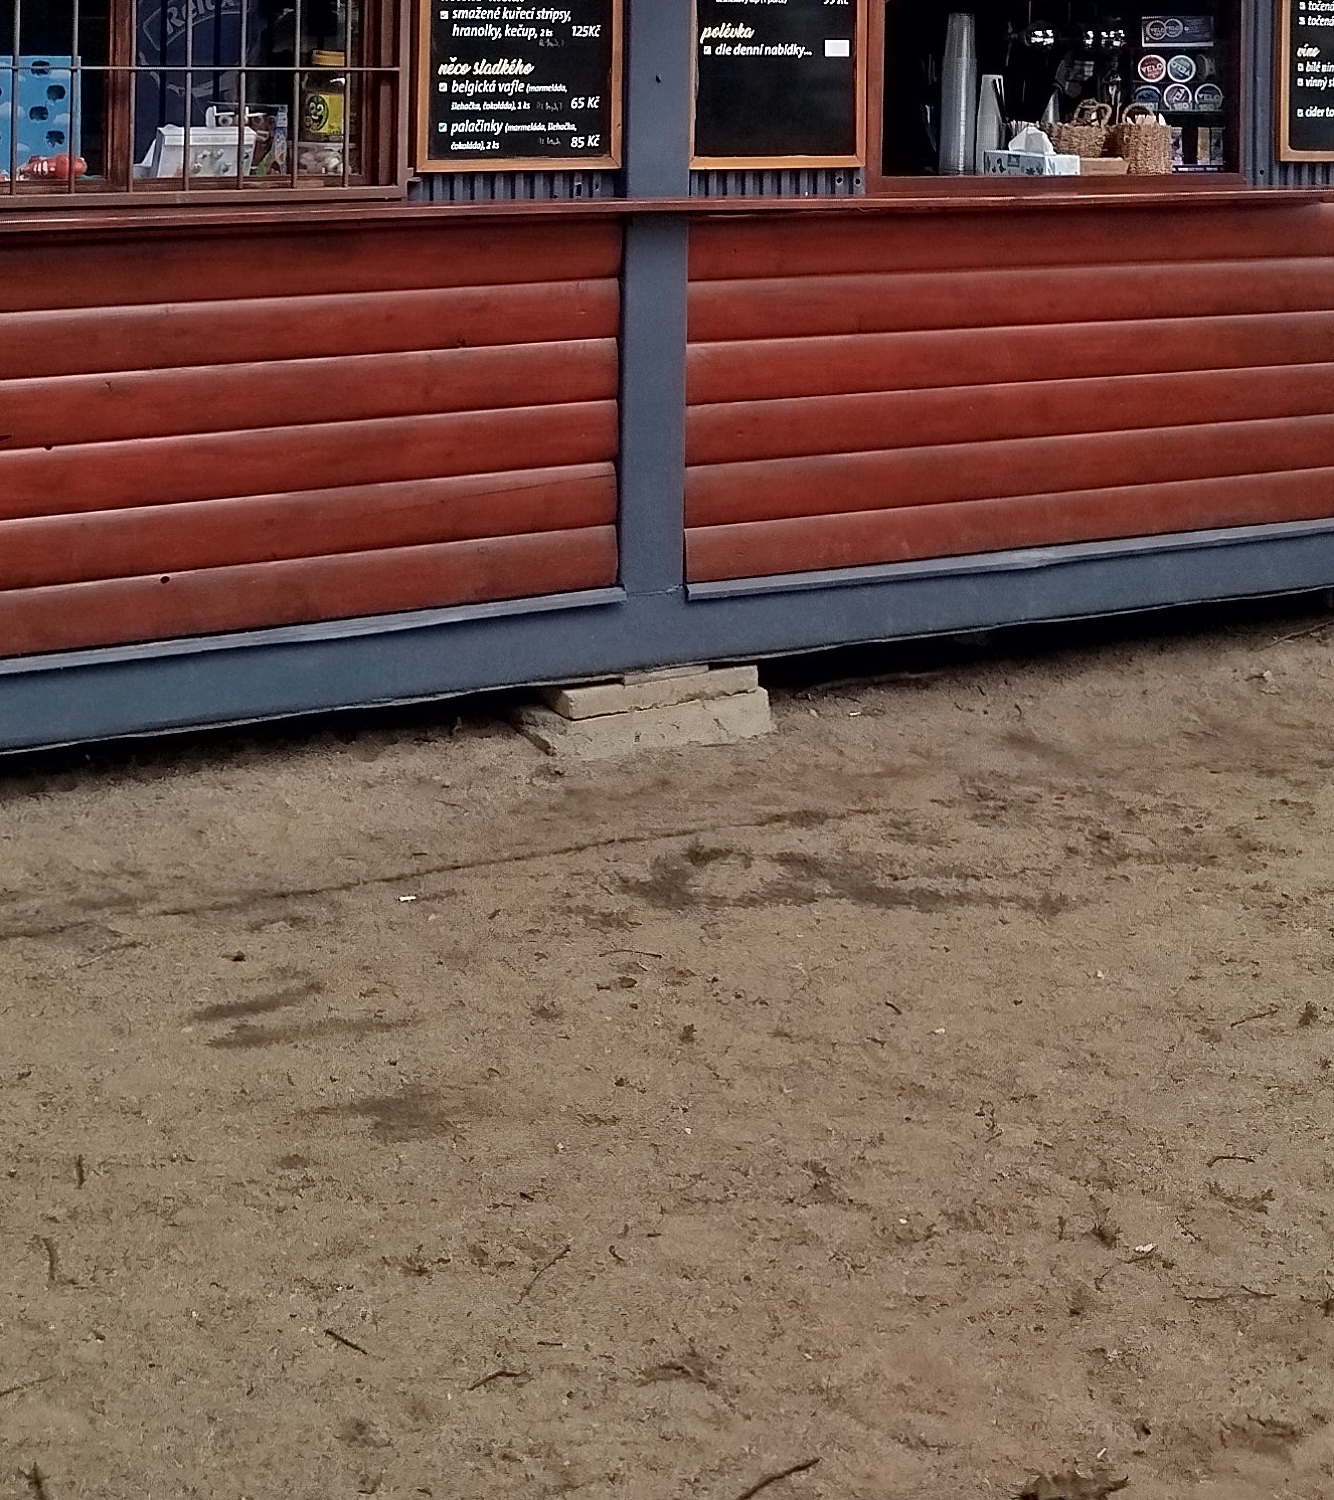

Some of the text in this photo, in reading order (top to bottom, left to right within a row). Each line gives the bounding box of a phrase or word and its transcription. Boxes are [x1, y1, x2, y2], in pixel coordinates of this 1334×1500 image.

[1308, 0, 1334, 11] točená
[452, 6, 571, 23] smažené kuřecí stripsy,
[700, 22, 755, 44] polévka
[715, 43, 732, 55] dle
[733, 43, 764, 56] denní
[438, 57, 535, 75] něco sladkého
[451, 79, 525, 96] belgická vafle
[1305, 106, 1325, 117] cider
[450, 119, 600, 148] palačinky 85 Kč
